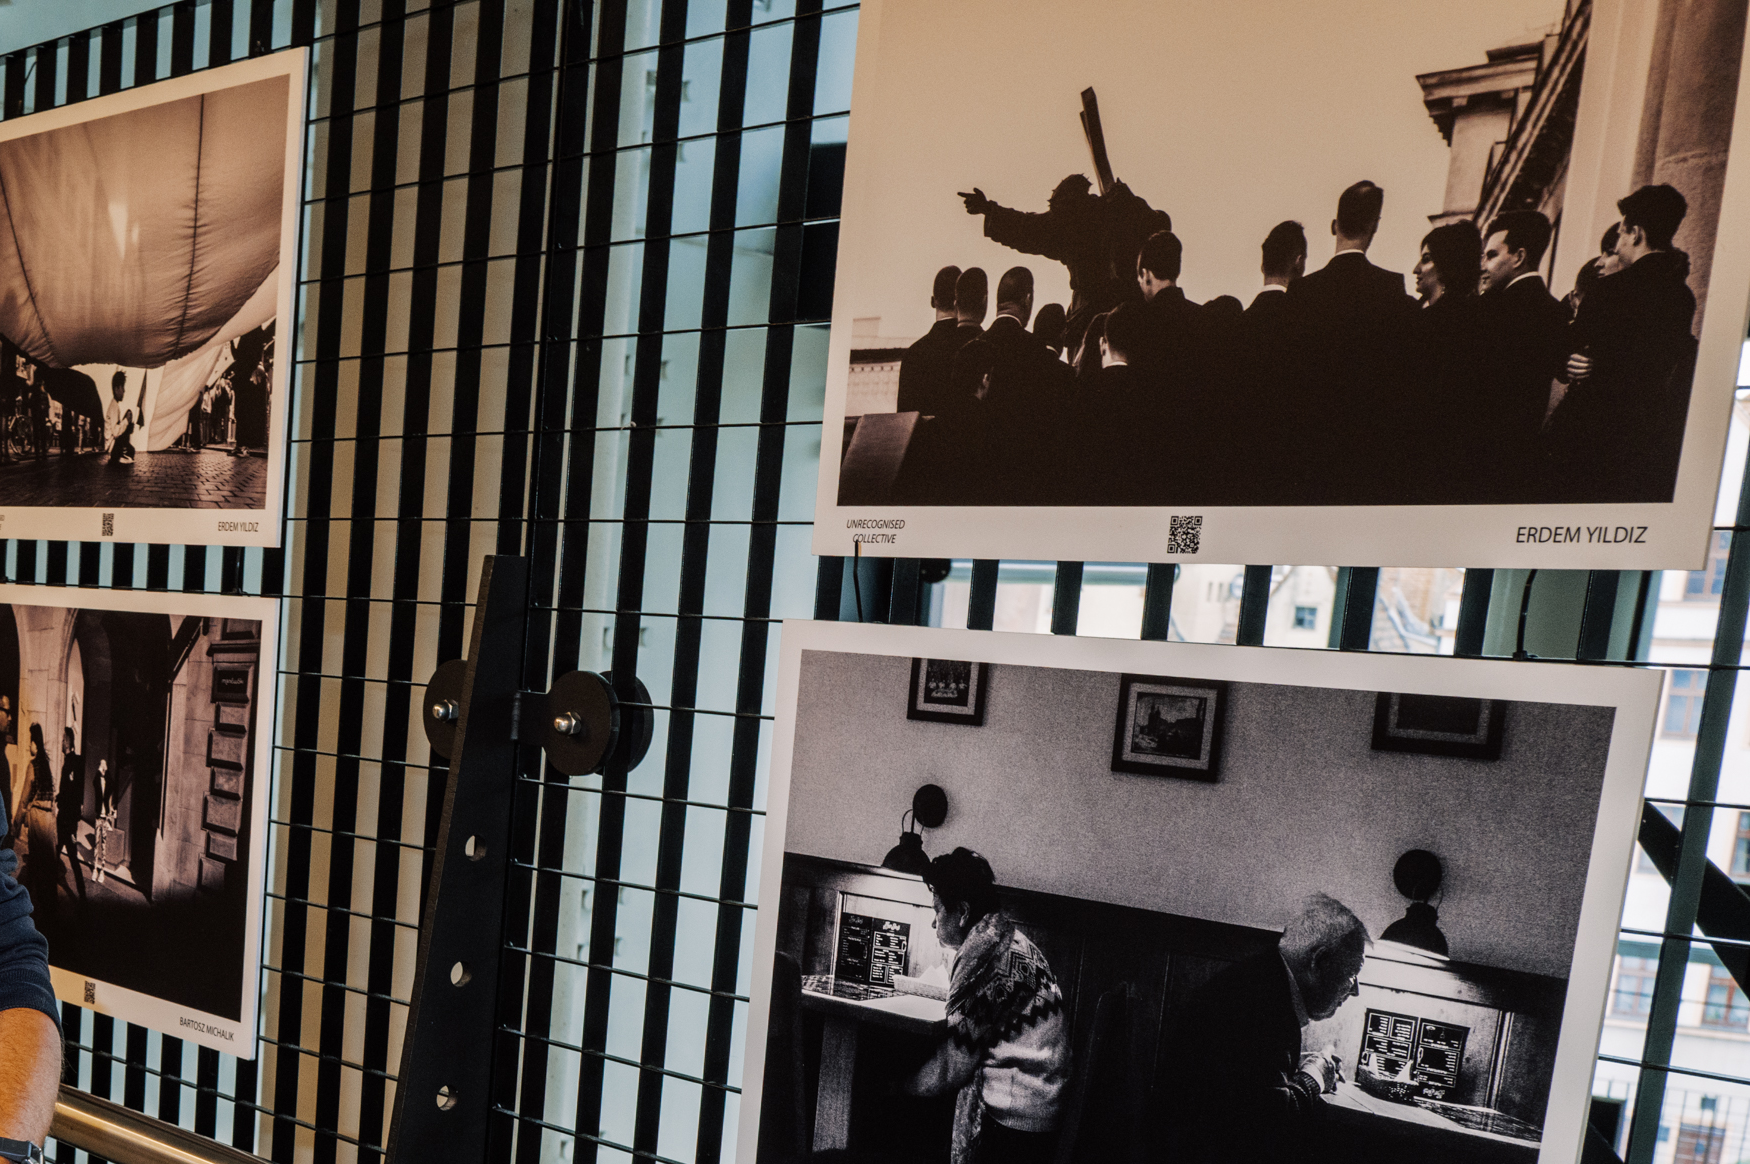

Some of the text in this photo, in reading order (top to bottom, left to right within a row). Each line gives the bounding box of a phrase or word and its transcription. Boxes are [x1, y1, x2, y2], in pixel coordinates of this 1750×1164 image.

[218, 521, 259, 533] ERDEM YILDIZ
[846, 519, 906, 529] UNRECOGNISED
[852, 533, 897, 544] COLLECTIVE
[1515, 526, 1649, 543] ERDEM YILDIZ
[179, 1016, 235, 1042] BARTOSZ MICHALIK
